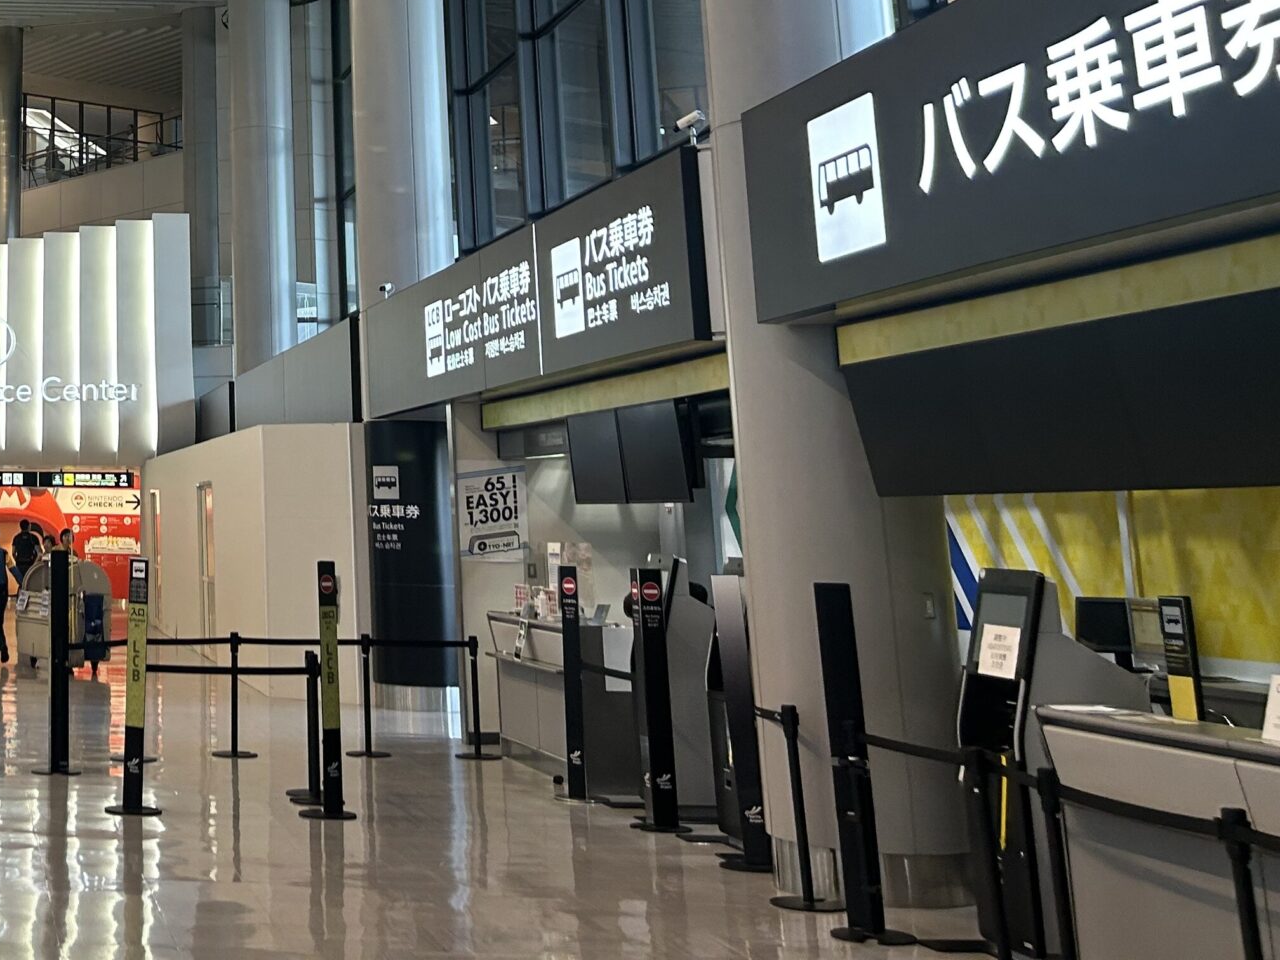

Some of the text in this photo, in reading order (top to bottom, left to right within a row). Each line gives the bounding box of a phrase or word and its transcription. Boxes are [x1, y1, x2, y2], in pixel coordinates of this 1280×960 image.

[584, 205, 654, 266] バス乗車券
[444, 260, 531, 323] ローコスト バス乗車券
[585, 254, 649, 301] Bus Tickets
[428, 305, 440, 327] LCB
[445, 296, 536, 350] Low Cost Bus Tickets
[40, 375, 139, 403] Center
[484, 475, 506, 492] 65
[372, 521, 405, 531] Bus Tickets
[130, 607, 145, 617] 入口
[132, 640, 140, 682] LCB
[325, 643, 335, 684] LCB
